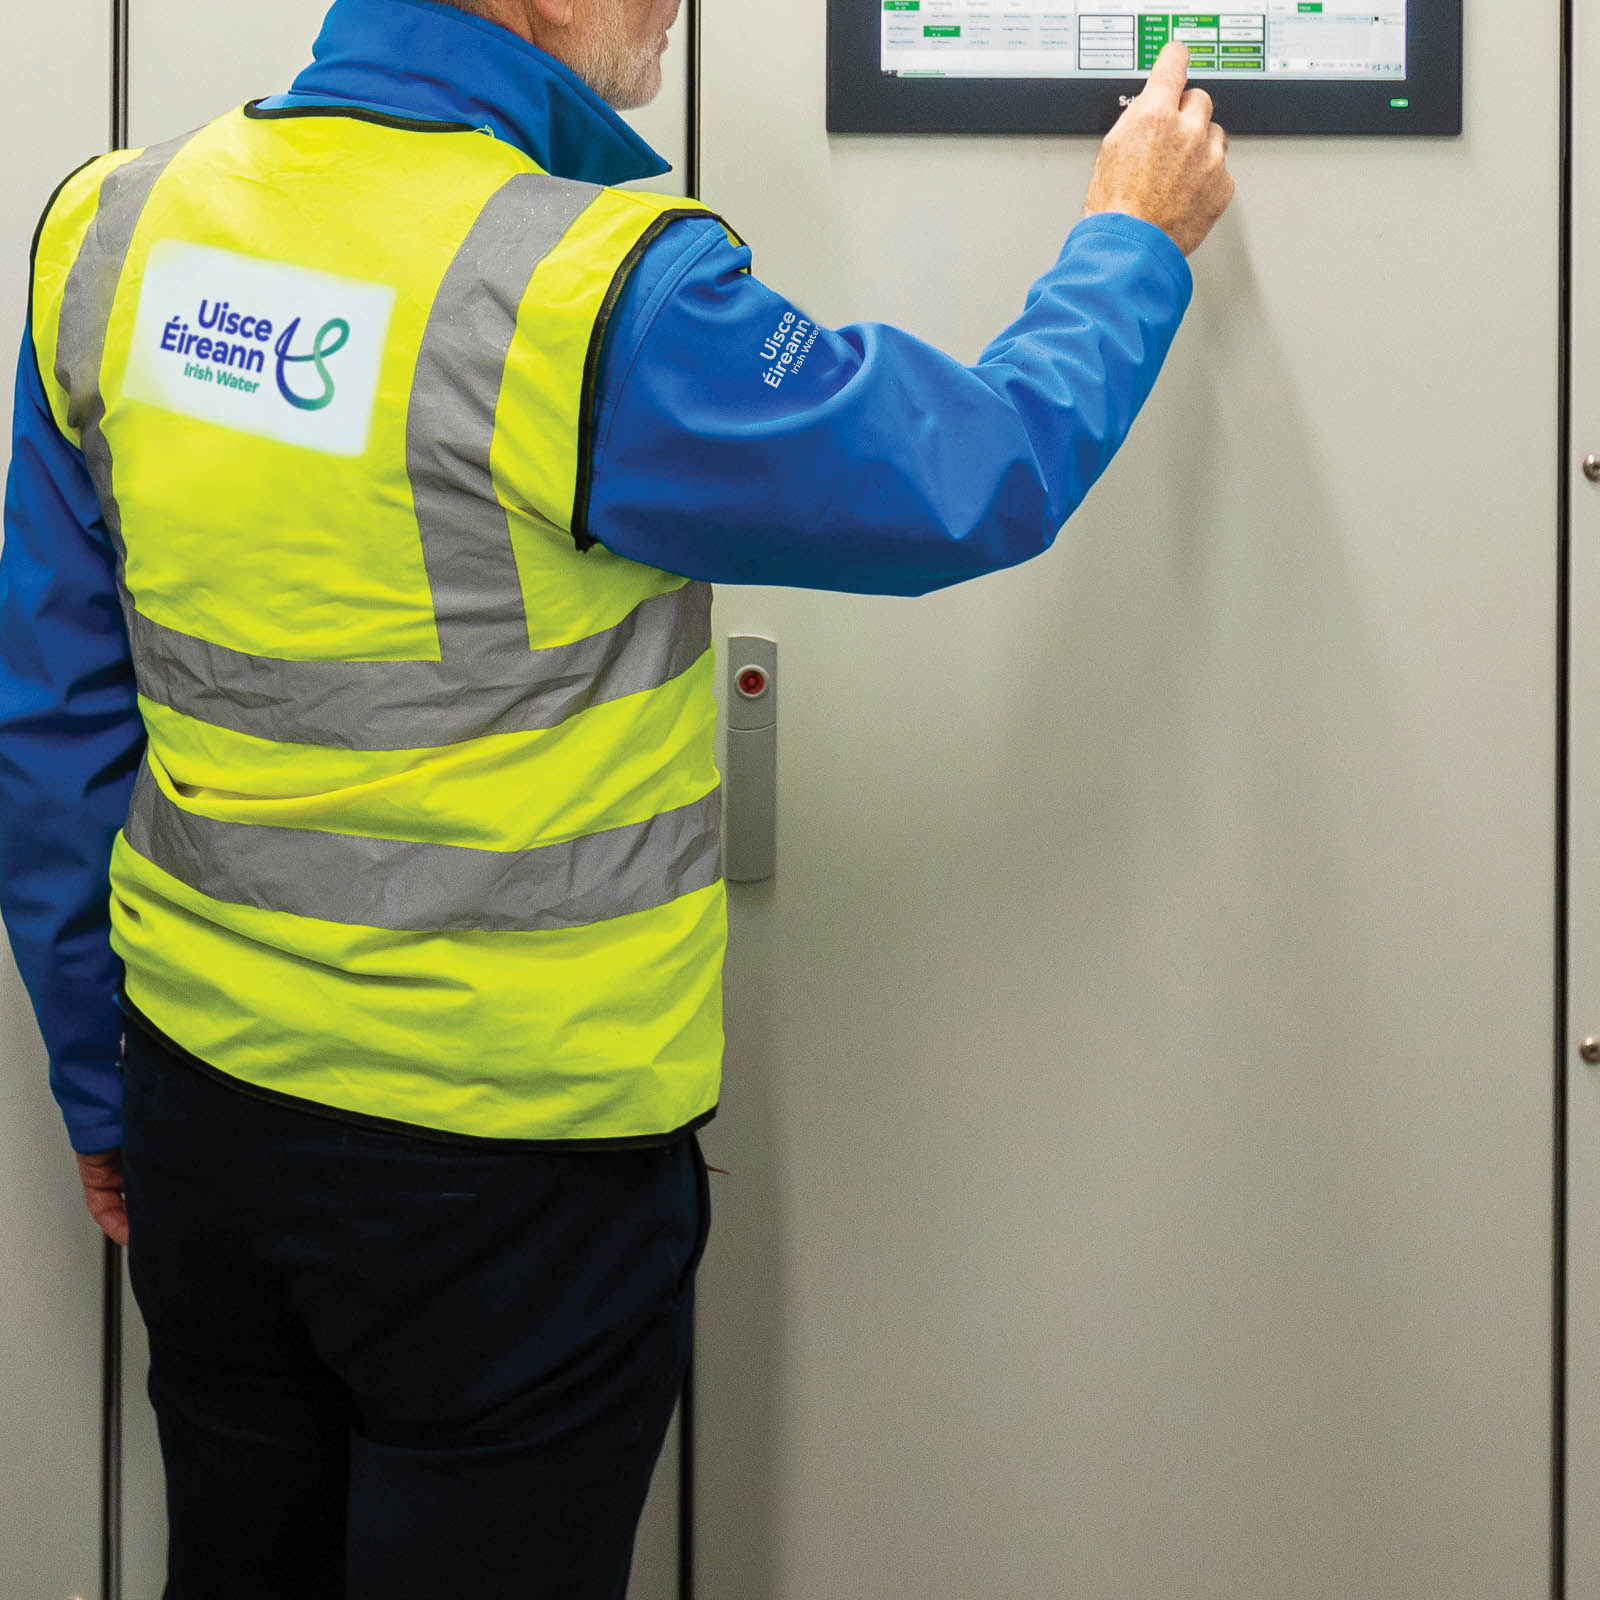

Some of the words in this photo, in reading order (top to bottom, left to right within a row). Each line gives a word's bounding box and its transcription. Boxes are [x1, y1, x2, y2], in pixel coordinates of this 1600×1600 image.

[160, 315, 265, 374] Éireann
[198, 299, 272, 342] Uisce
[760, 311, 796, 360] Uisce
[762, 319, 811, 389] Éireann
[790, 354, 806, 375] Irish
[801, 325, 821, 353] Water
[184, 362, 213, 383] Irish
[216, 369, 260, 394] Water
